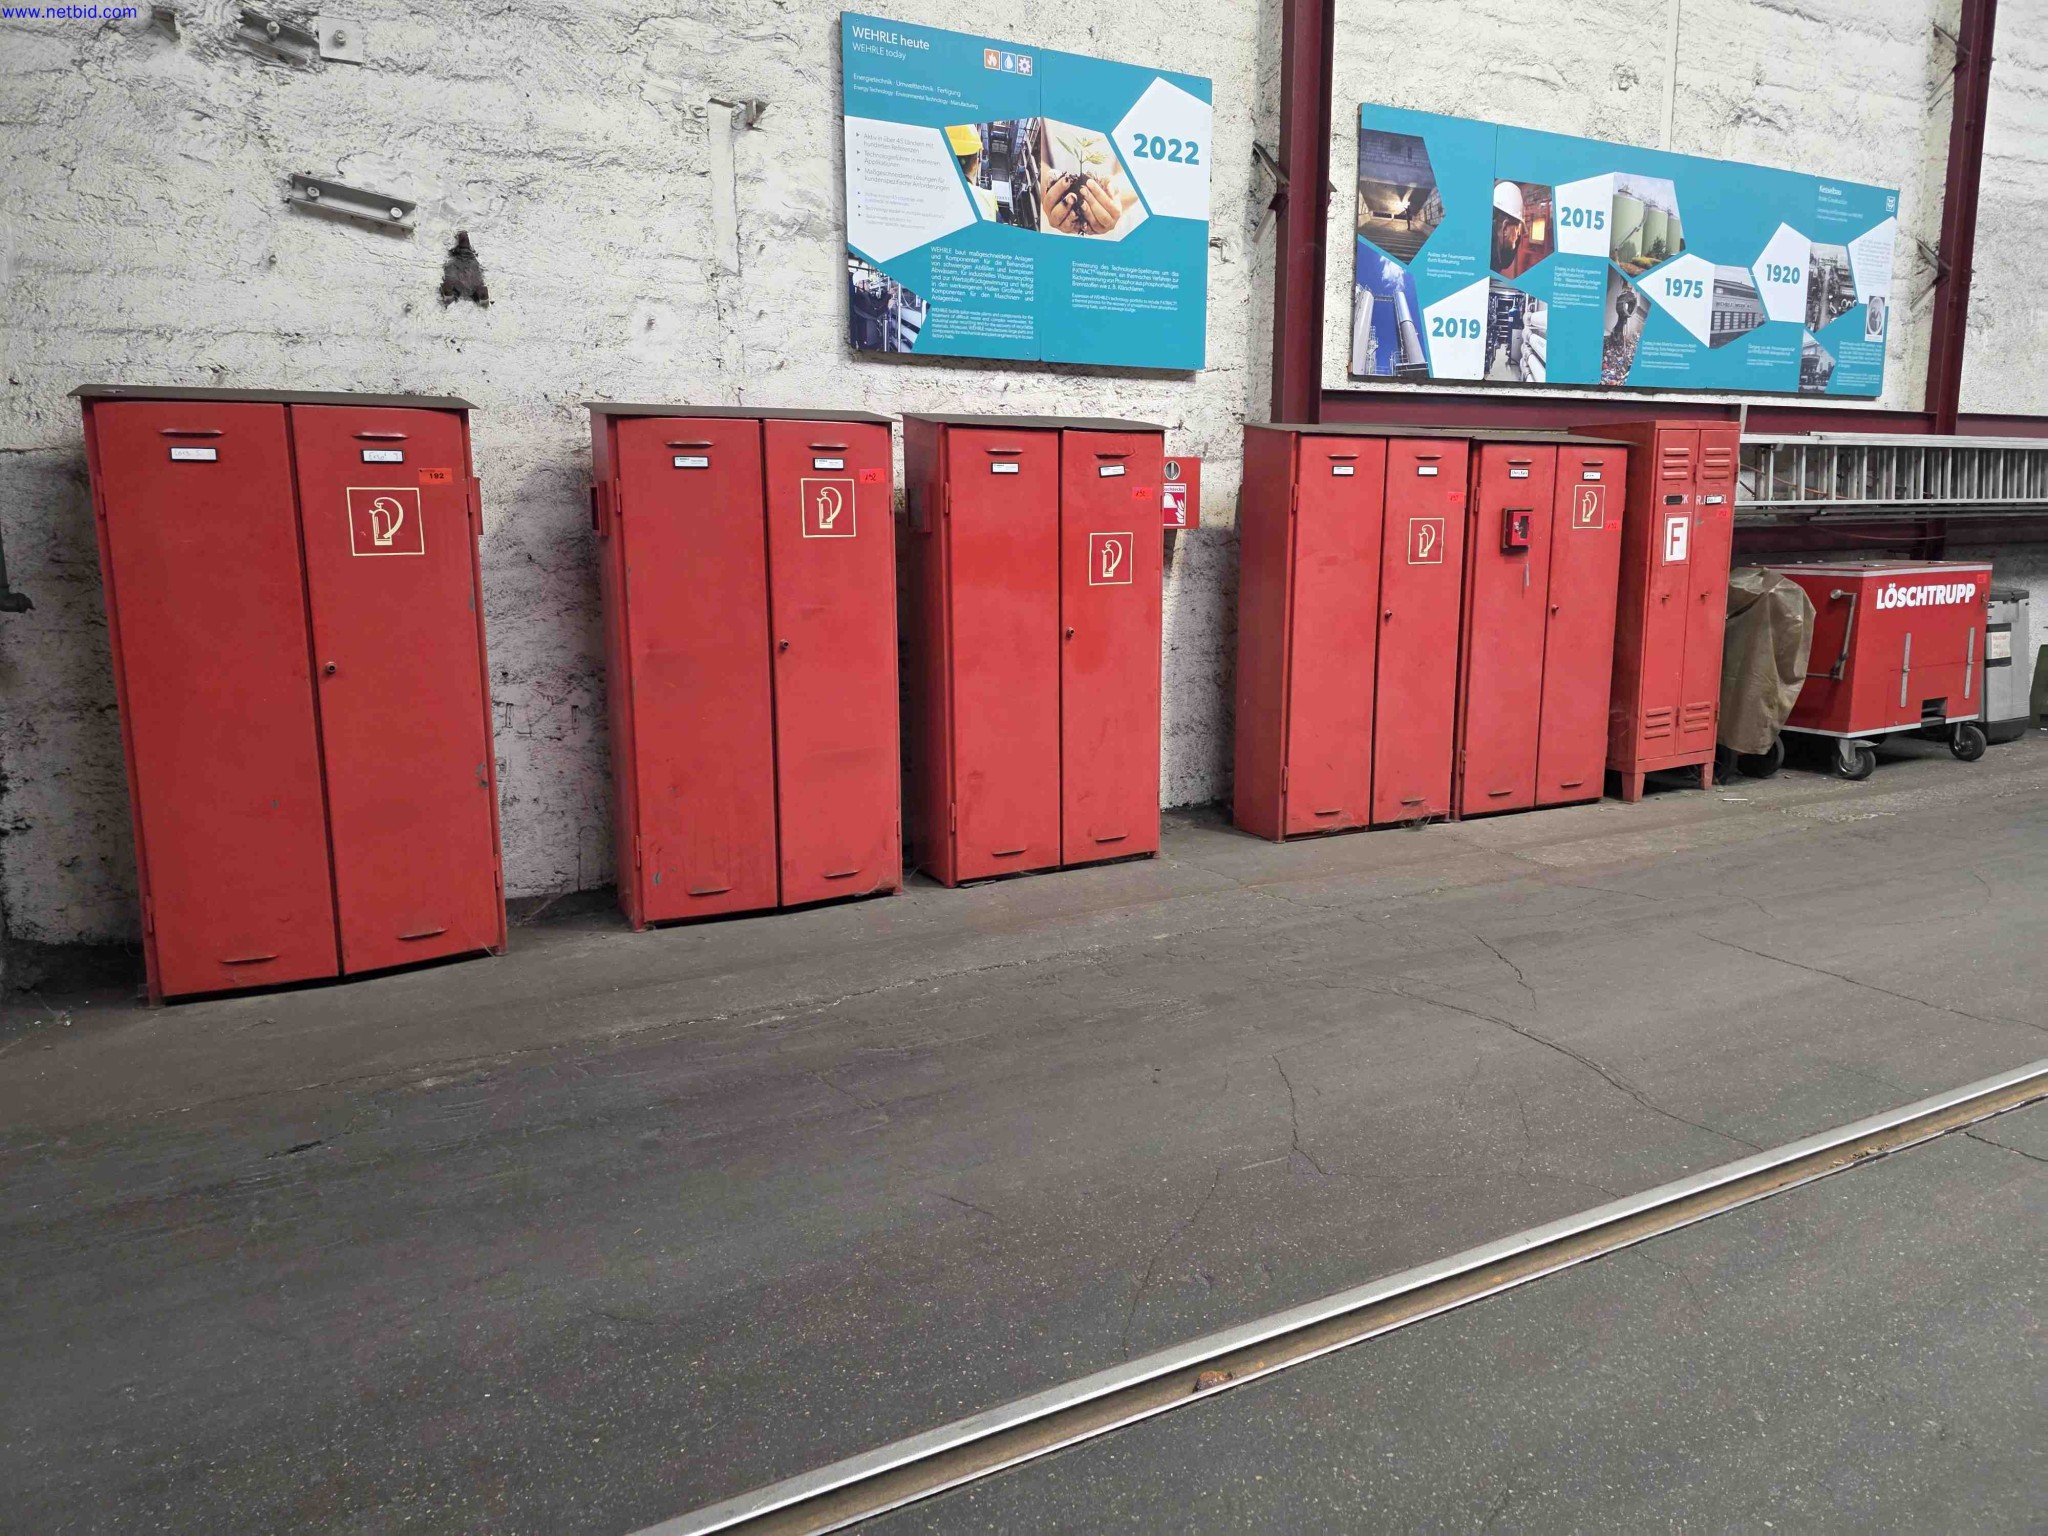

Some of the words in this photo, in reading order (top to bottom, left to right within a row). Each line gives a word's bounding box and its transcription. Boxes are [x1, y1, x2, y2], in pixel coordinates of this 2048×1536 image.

[852, 26, 898, 45] WEHRLE
[901, 35, 930, 50] heute
[852, 43, 884, 55] WEHRLE
[886, 50, 906, 60] today
[854, 73, 892, 85] Energietechnik
[896, 81, 933, 92] Umwelttechnik
[937, 87, 961, 97] Fertigung
[854, 84, 868, 93] Energy
[869, 86, 893, 96] Technology
[864, 133, 877, 141] Aktiv
[1134, 134, 1200, 165] 2022
[1561, 207, 1605, 231] 2015
[931, 246, 952, 254] WEHRLE
[946, 255, 979, 263] Komponenten
[1766, 264, 1800, 284] 1920
[1666, 278, 1703, 299] 1975
[1432, 317, 1481, 339] 2019
[1670, 523, 1684, 555] F
[1876, 583, 1976, 610] LÖSCHTRUPP
